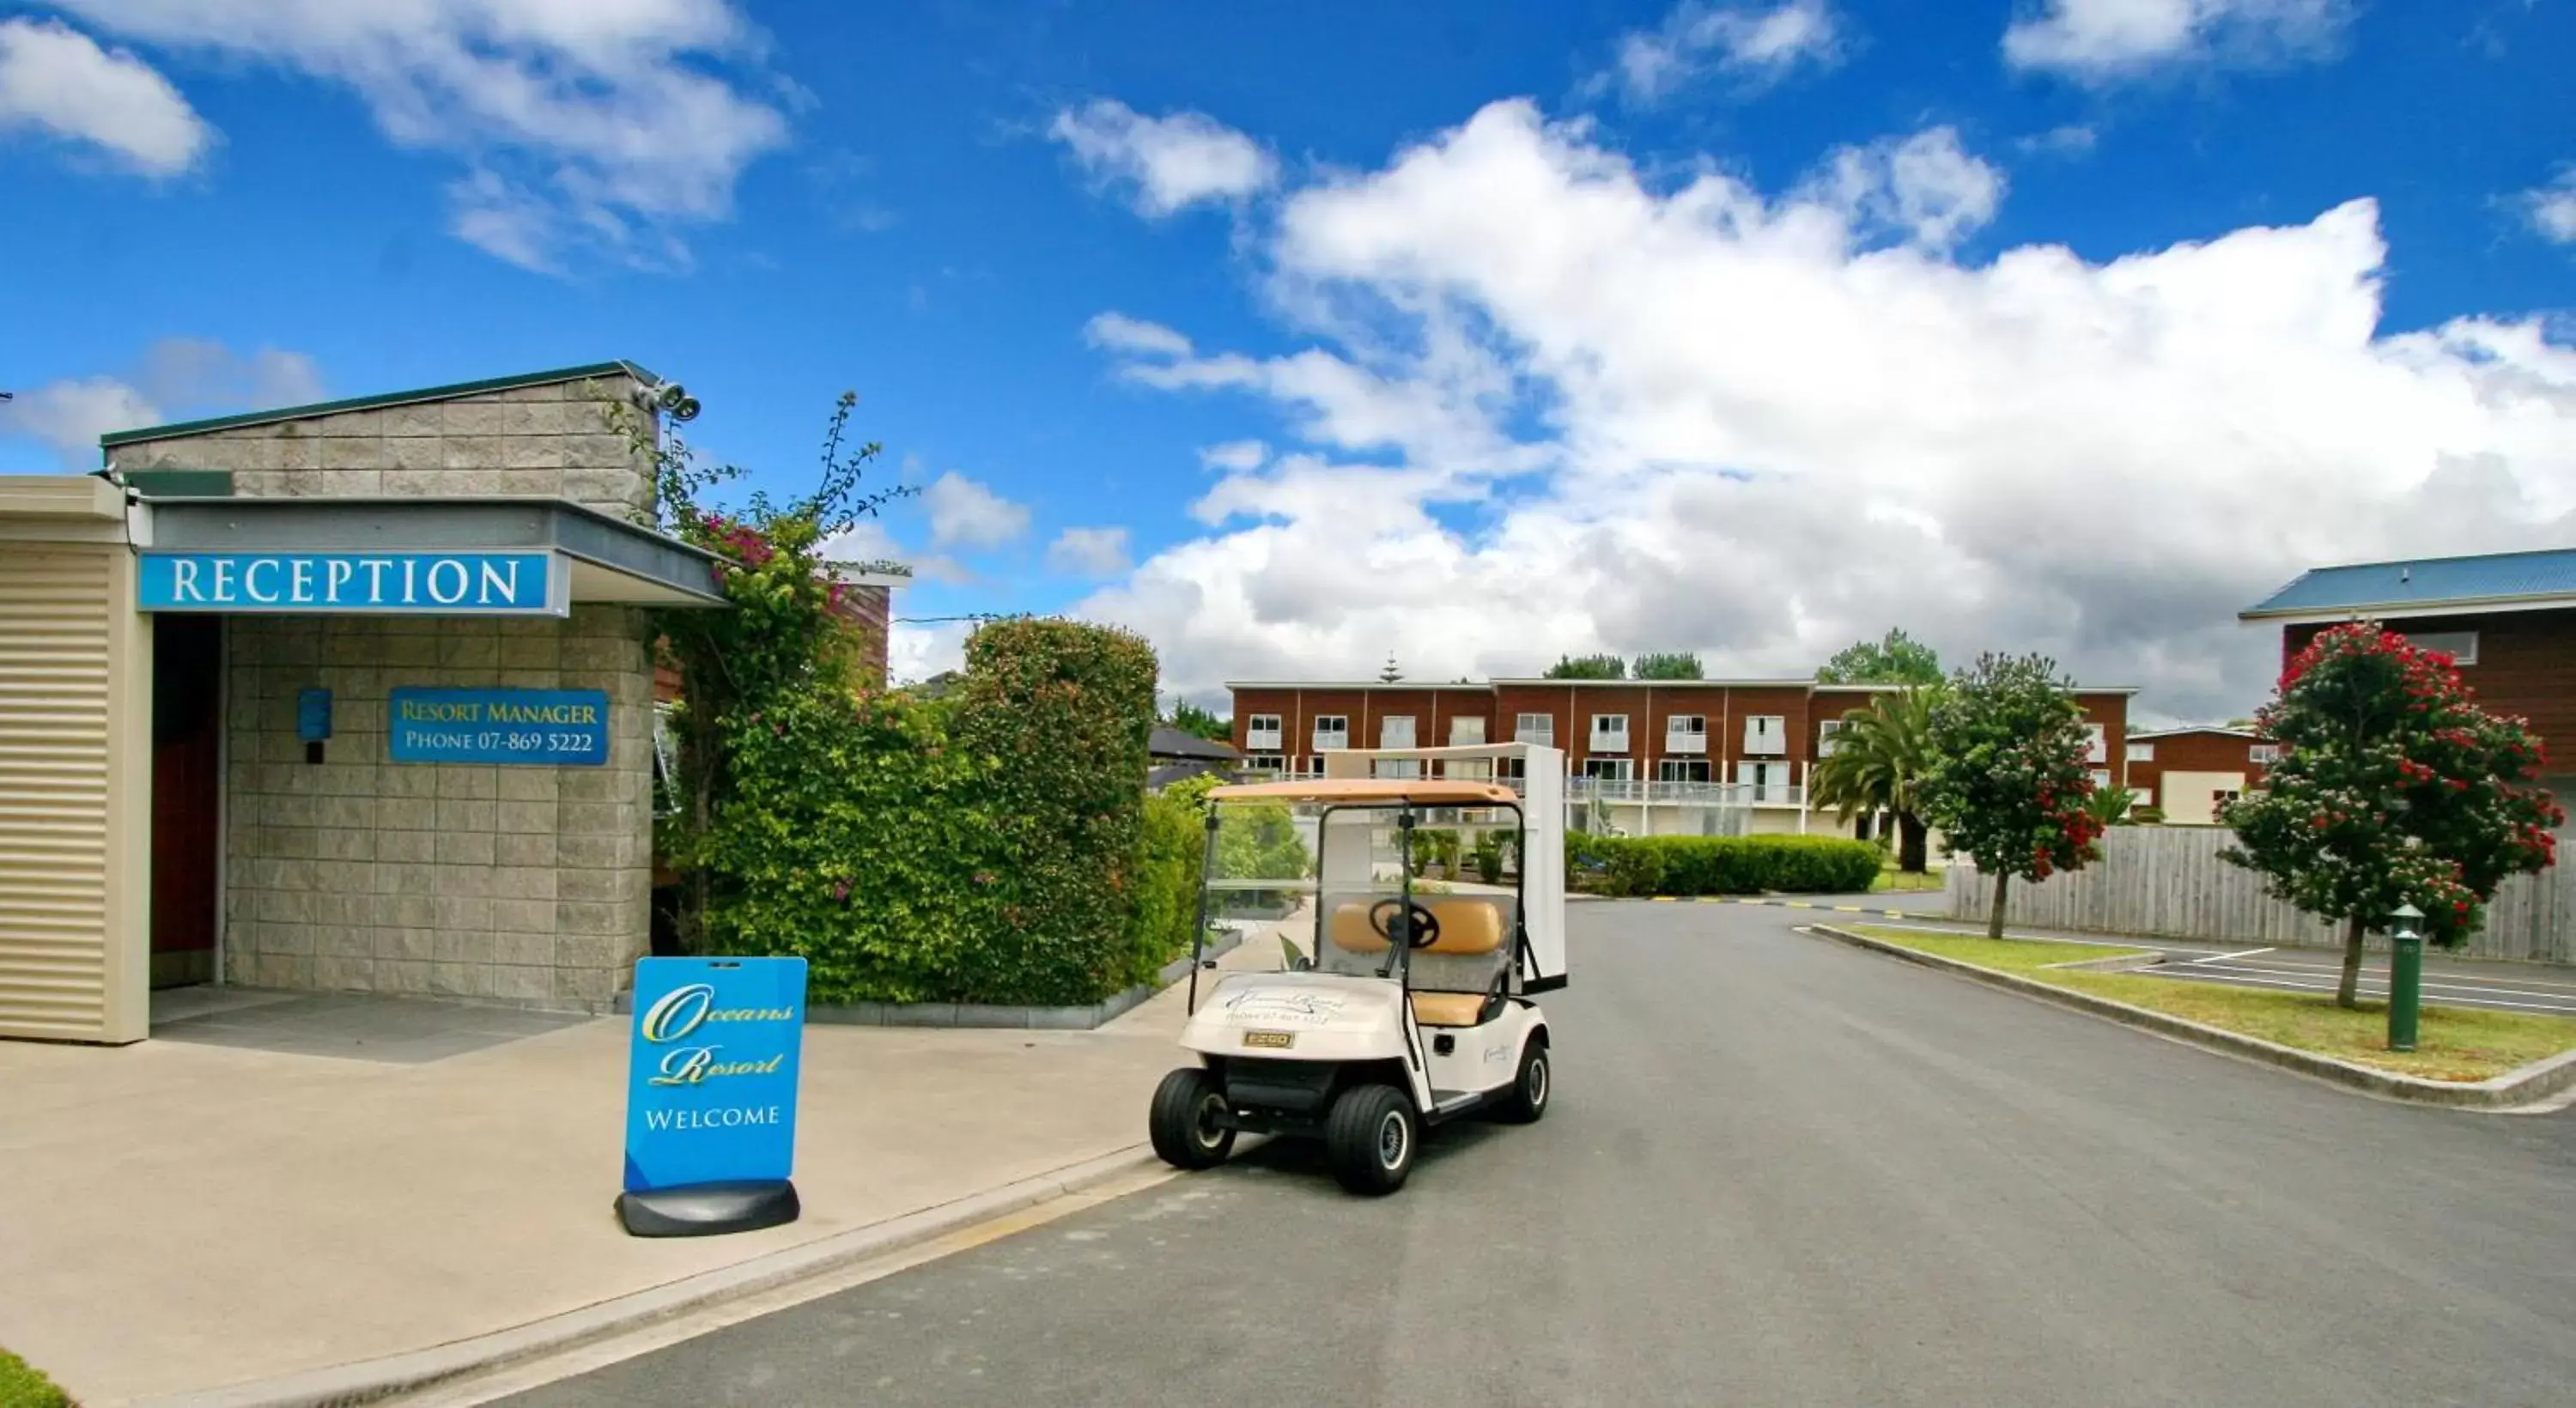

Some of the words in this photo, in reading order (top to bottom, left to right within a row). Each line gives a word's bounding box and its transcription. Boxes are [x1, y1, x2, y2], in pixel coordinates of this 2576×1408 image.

[173, 560, 519, 604] RECEPTION
[401, 701, 481, 722] RESORT
[488, 704, 597, 725] MANAGER
[406, 731, 472, 751] PHONE
[477, 733, 542, 751] 07-869
[548, 734, 592, 752] 5222
[642, 983, 794, 1042] Oceans
[647, 1045, 785, 1086] Resort
[646, 1106, 780, 1130] WELCOME
